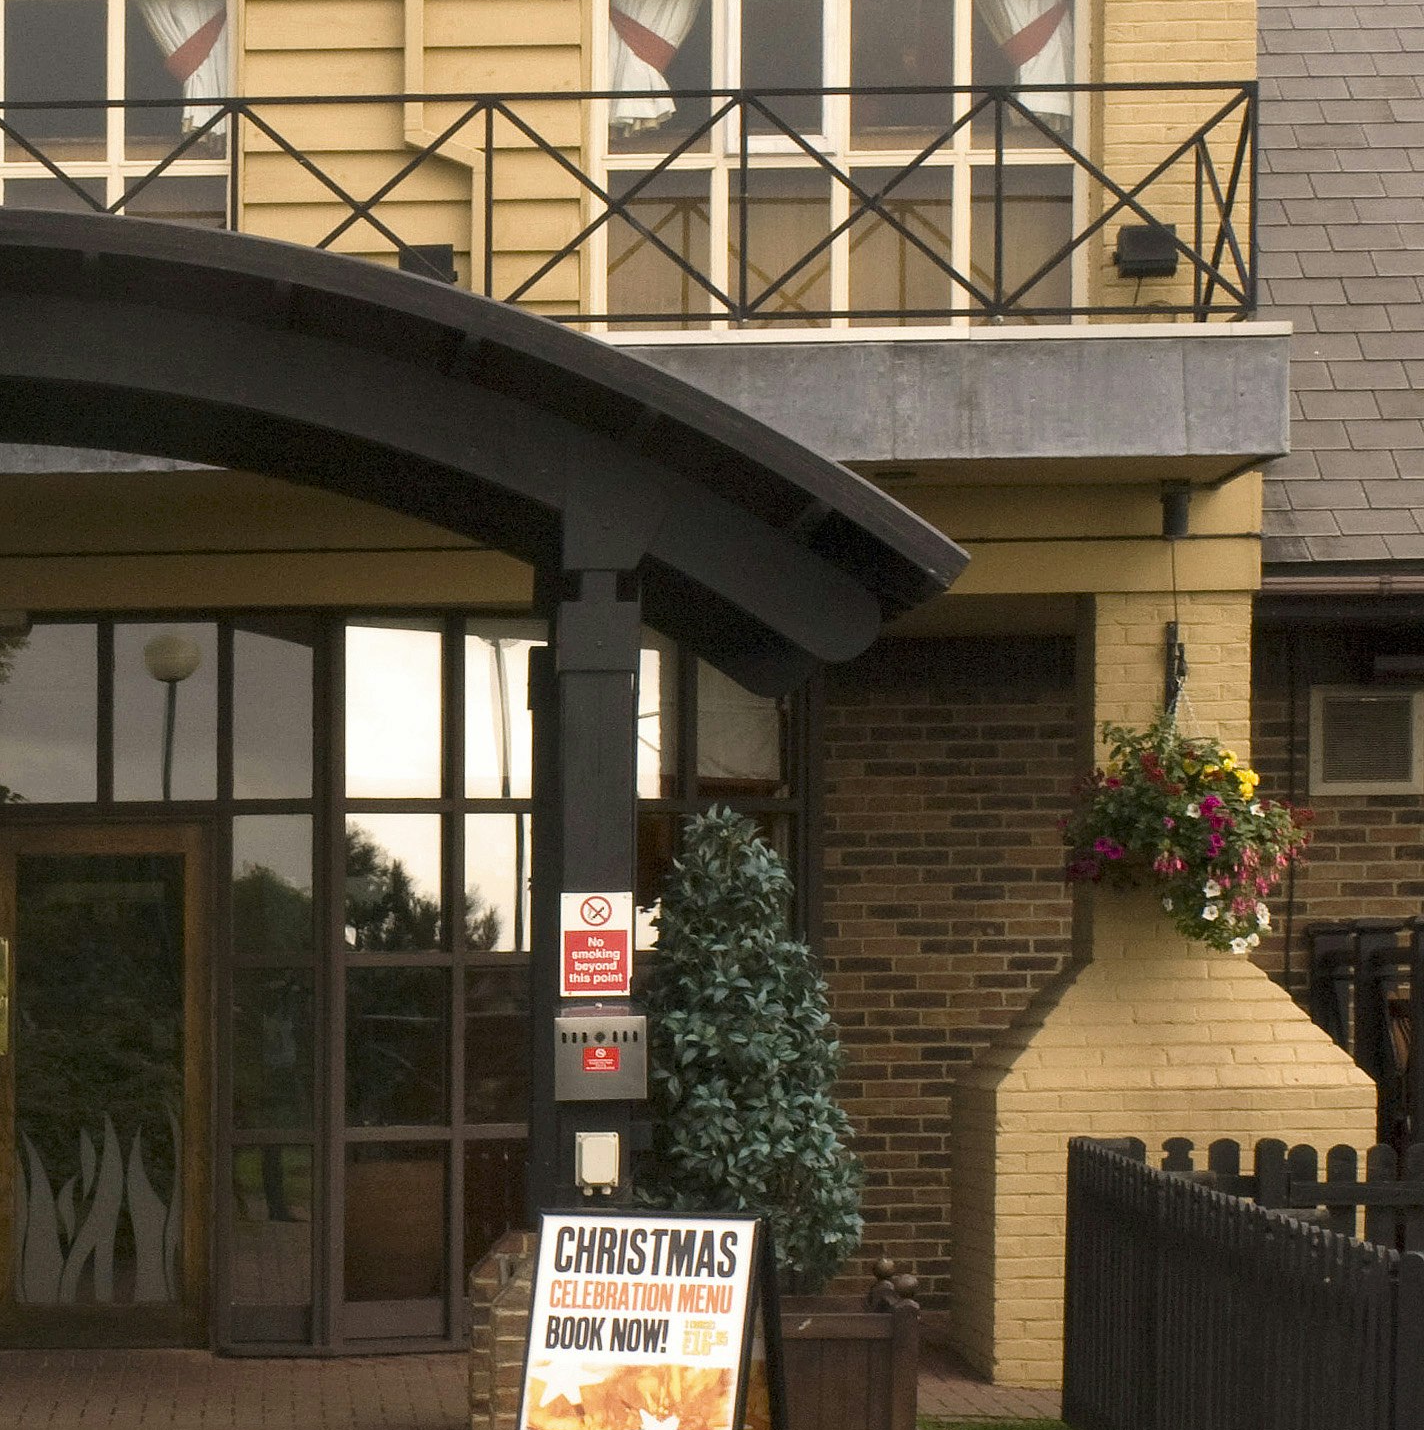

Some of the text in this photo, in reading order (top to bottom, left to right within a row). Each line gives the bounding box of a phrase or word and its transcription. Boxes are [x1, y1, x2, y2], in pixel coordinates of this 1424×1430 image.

[588, 936, 605, 947] No
[572, 950, 621, 961] smoking
[574, 961, 617, 973] beyond
[569, 973, 623, 985] this point
[554, 1226, 738, 1278] CHRISTMAS
[549, 1280, 733, 1314] CELEBRATION MENU
[545, 1315, 669, 1353] BOOK NOW!
